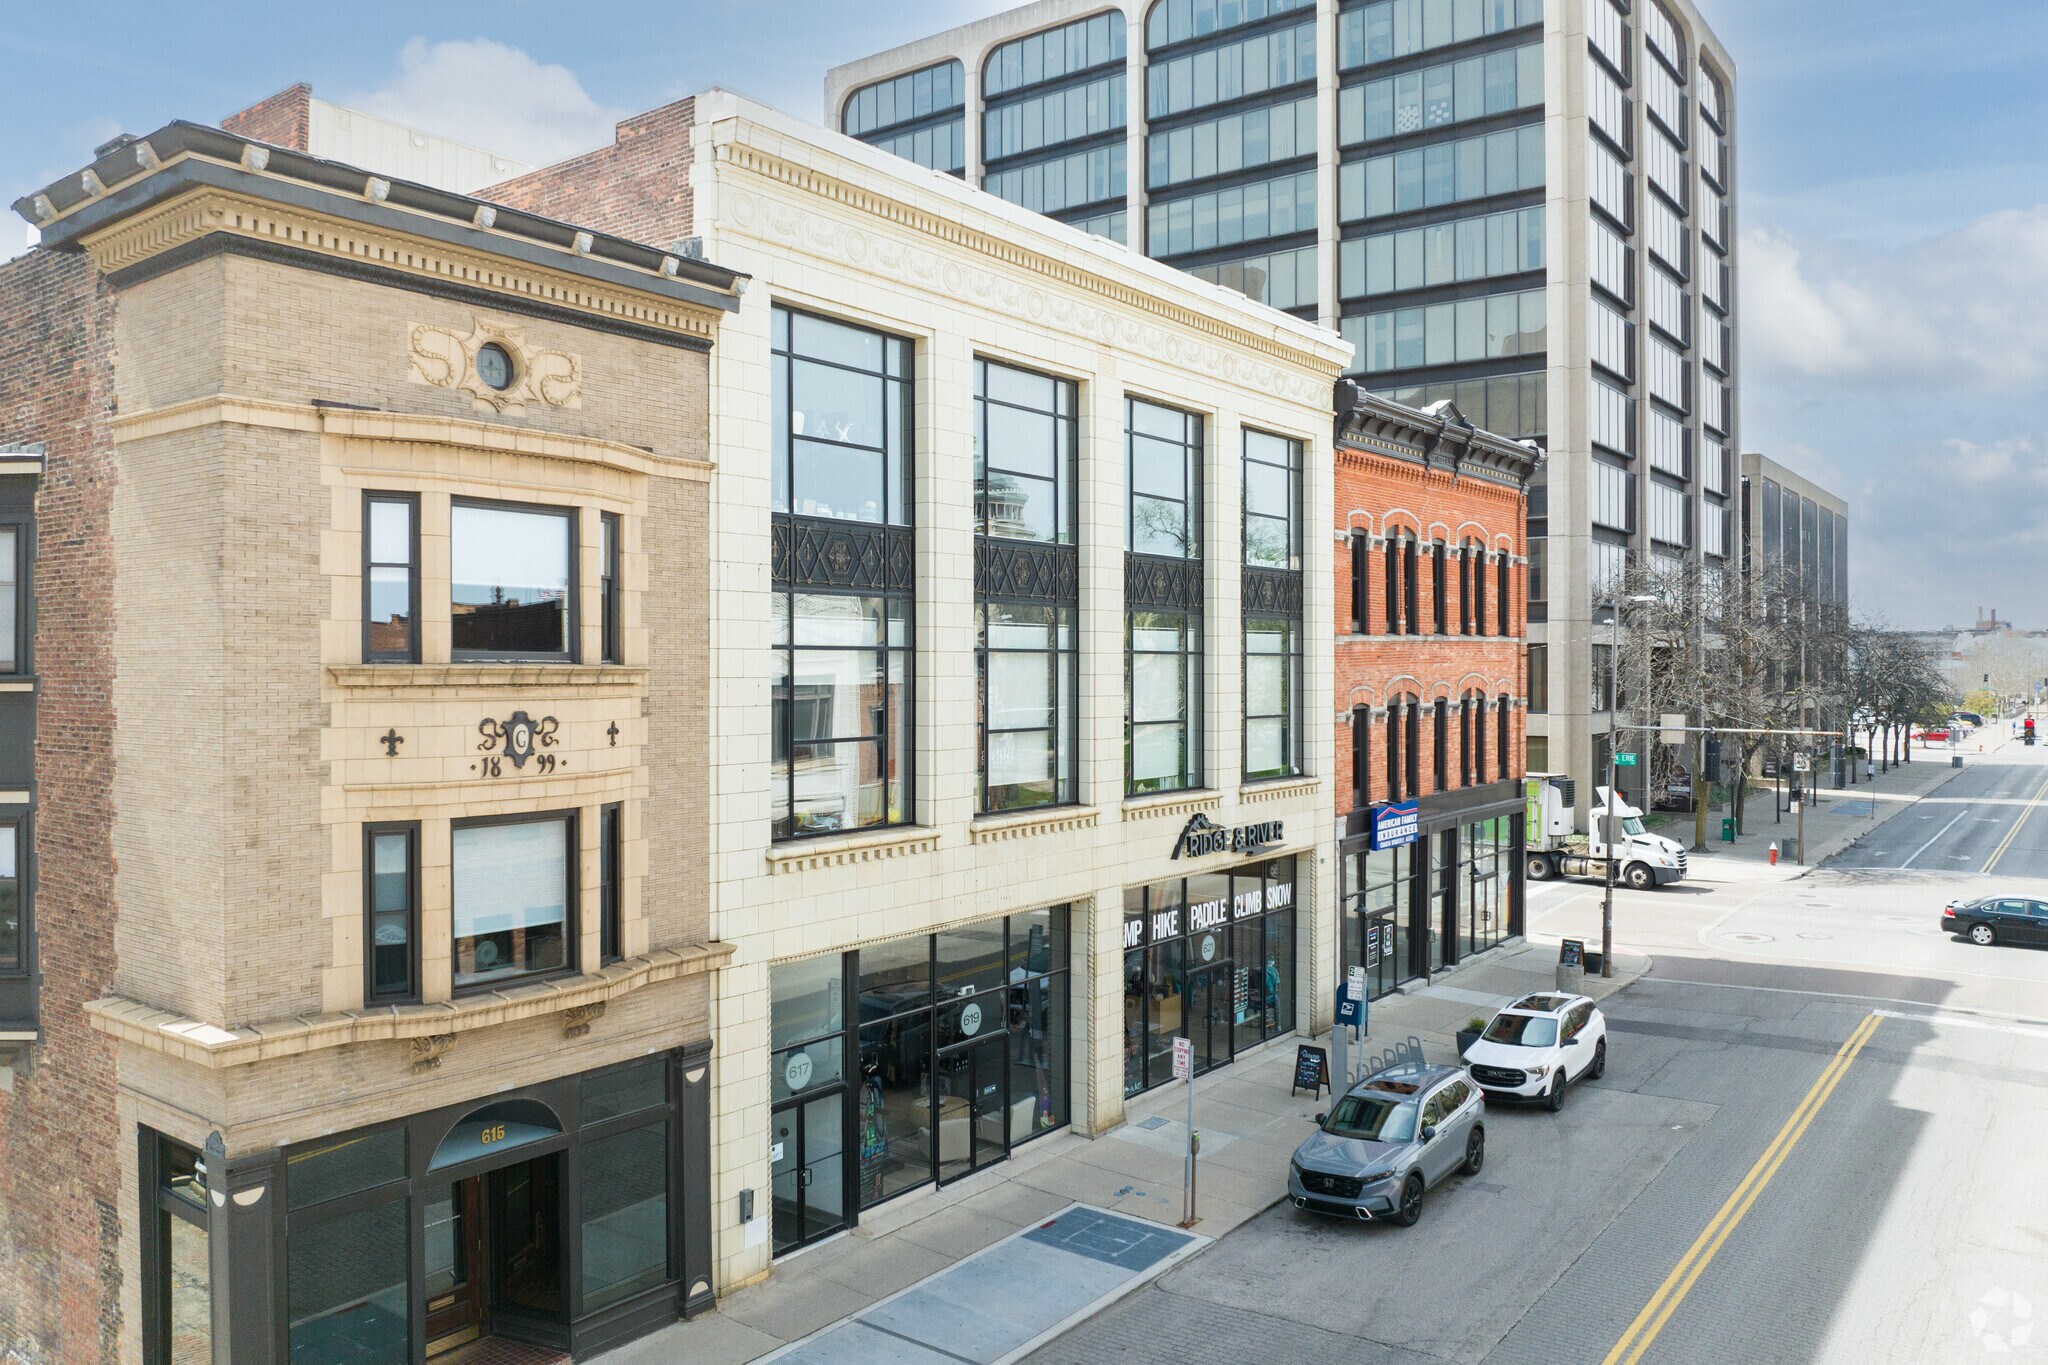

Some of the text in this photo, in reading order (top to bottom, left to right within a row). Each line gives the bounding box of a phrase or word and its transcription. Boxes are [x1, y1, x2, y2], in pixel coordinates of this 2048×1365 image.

[515, 729, 527, 748] C
[481, 754, 556, 777] 18 99
[1378, 813, 1418, 830] AMERICAN FAMILY
[1187, 820, 1284, 857] RIDGE & RIVER
[1379, 824, 1416, 839] INSURANCE
[1124, 883, 1292, 948] MP HIKE PADDLE CLIMB SNOW
[1203, 942, 1214, 953] 621
[963, 1012, 980, 1026] 619
[789, 1062, 810, 1079] 617
[481, 1124, 505, 1144] 615
